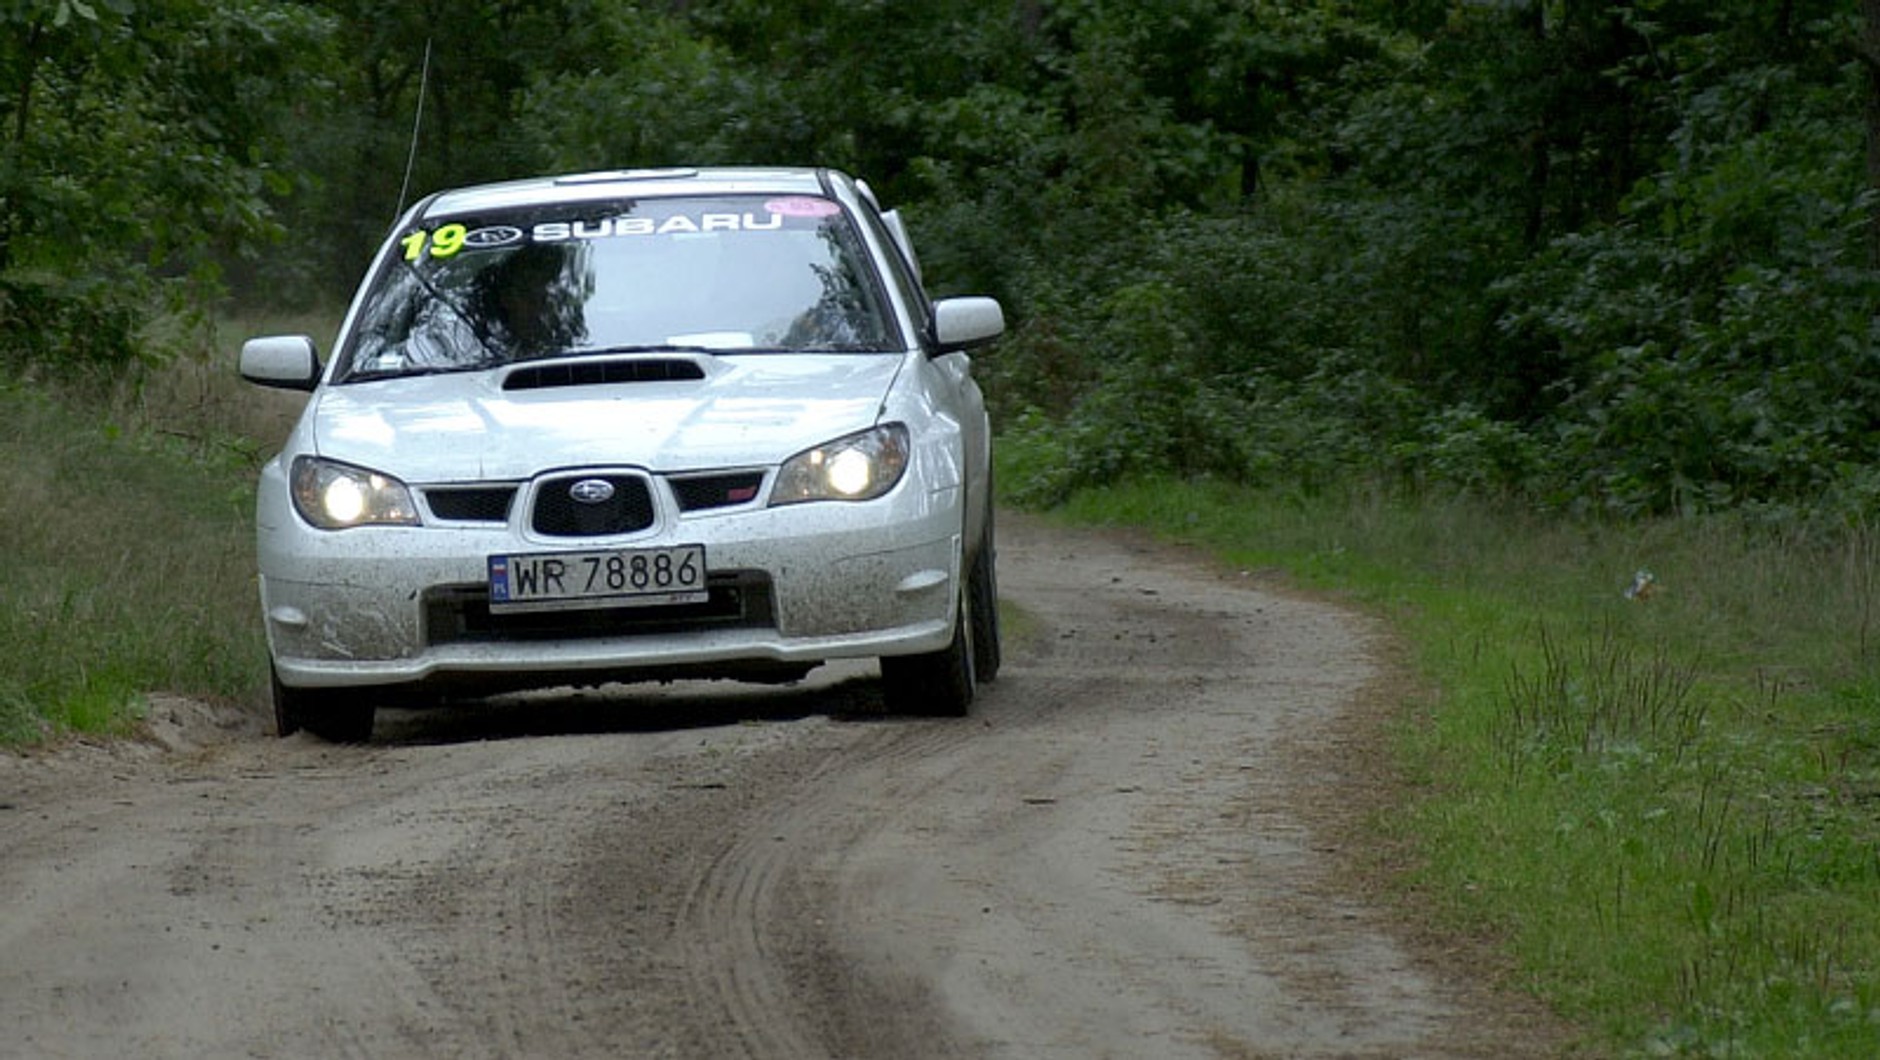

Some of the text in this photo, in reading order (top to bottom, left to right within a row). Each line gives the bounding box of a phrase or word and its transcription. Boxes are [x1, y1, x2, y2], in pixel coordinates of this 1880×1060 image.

[401, 223, 467, 260] 19
[532, 213, 782, 242] SUBARU
[514, 551, 697, 595] WR 78886
